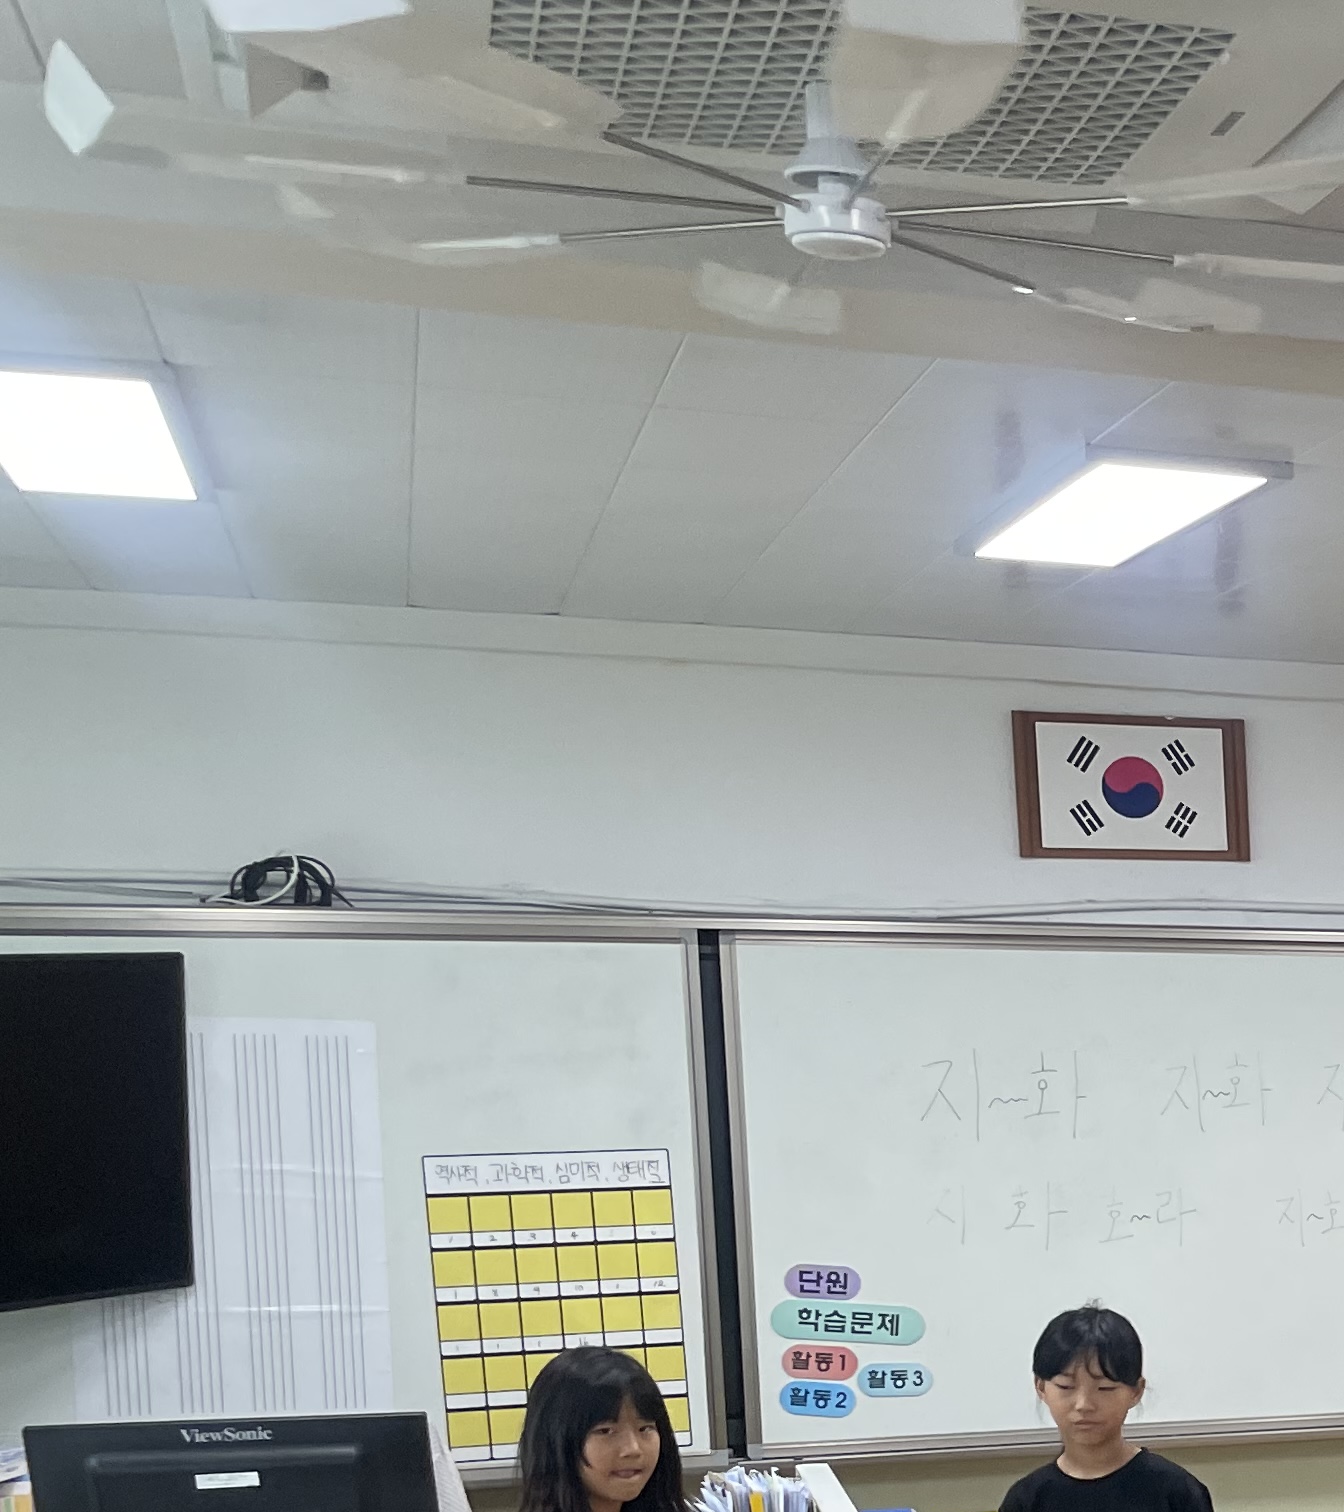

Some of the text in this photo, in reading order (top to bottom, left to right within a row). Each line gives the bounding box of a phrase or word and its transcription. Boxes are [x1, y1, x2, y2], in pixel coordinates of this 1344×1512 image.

[570, 1231, 579, 1240] 4
[798, 1270, 849, 1295] 단원
[797, 1307, 901, 1337] 학습문제
[180, 1426, 273, 1443] ViewSonic
